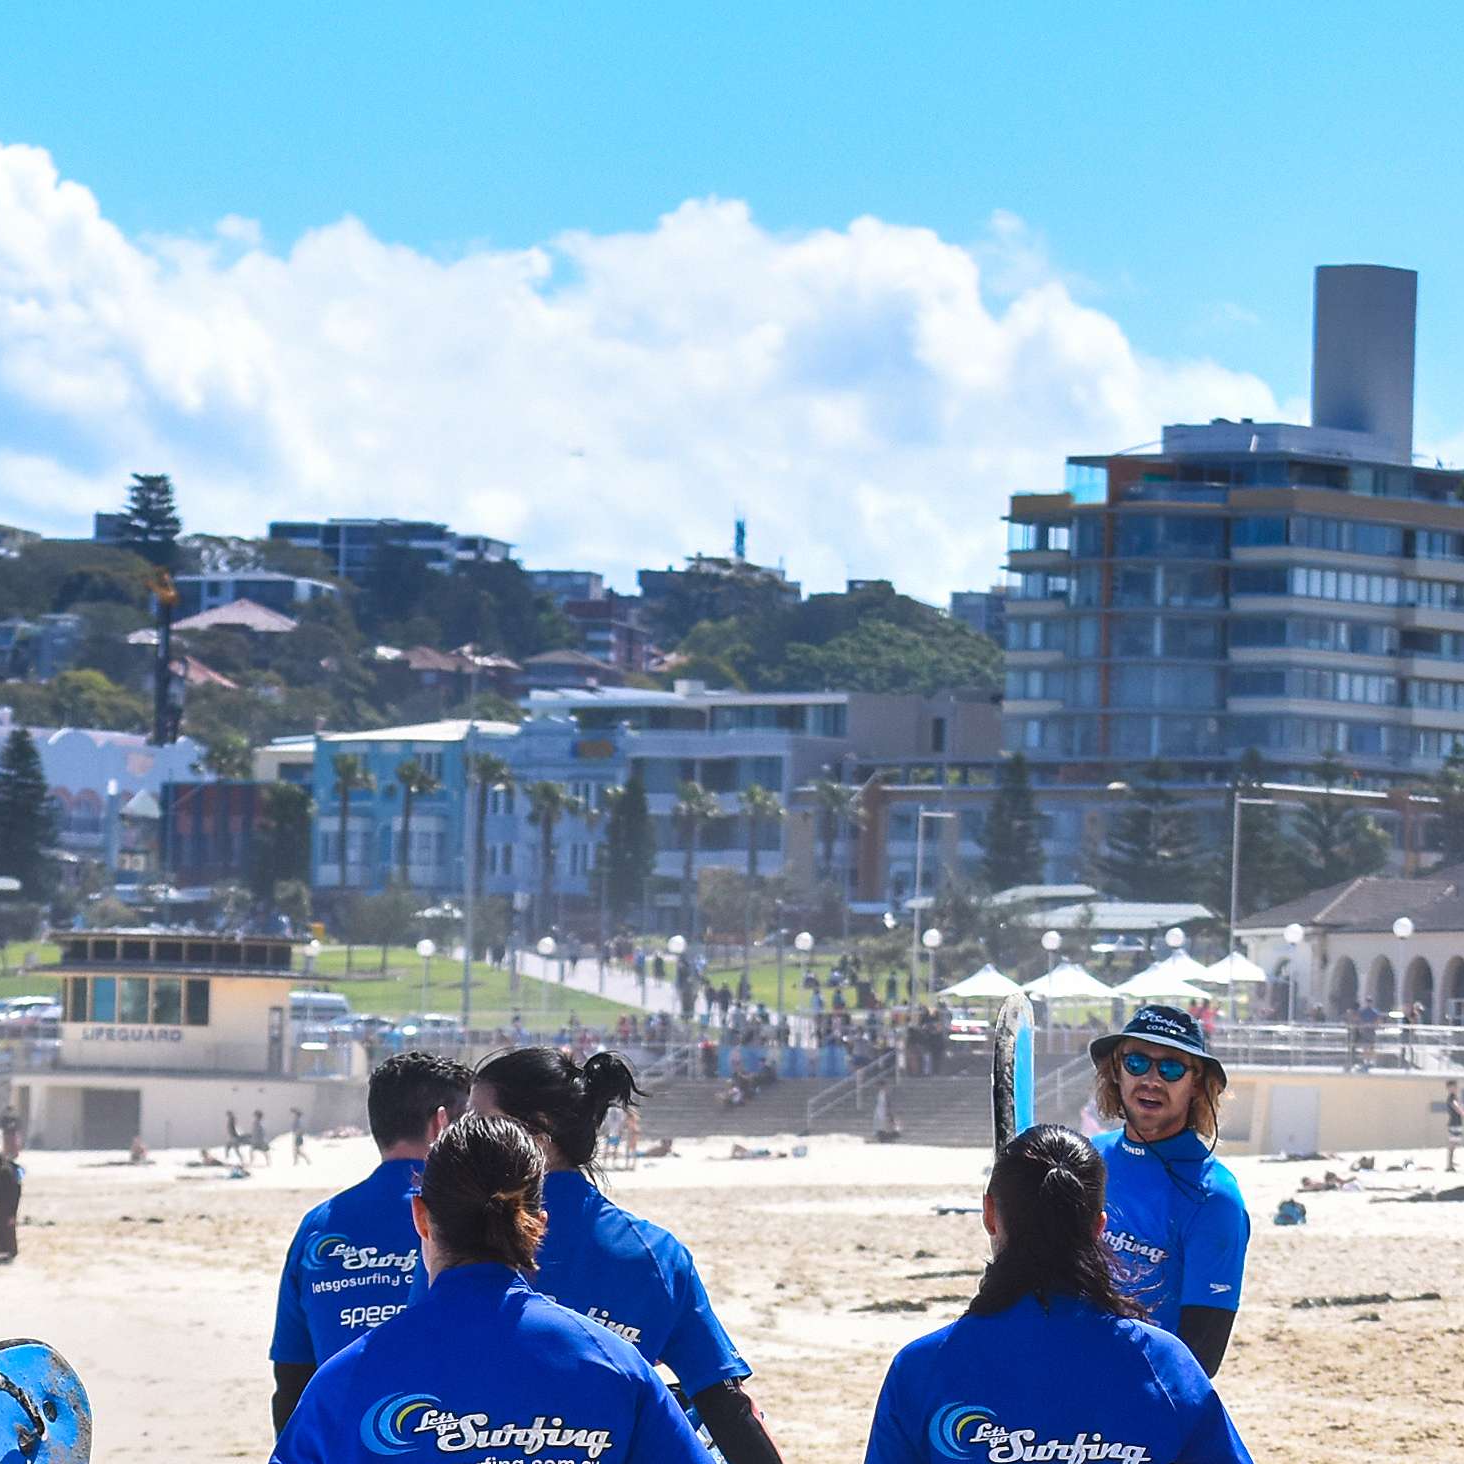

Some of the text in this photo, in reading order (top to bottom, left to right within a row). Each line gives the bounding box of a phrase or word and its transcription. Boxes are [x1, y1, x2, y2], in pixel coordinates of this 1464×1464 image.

[81, 1027, 183, 1041] LIFEGUARD
[1146, 1024, 1177, 1035] COAC
[437, 1413, 613, 1459] Surfing
